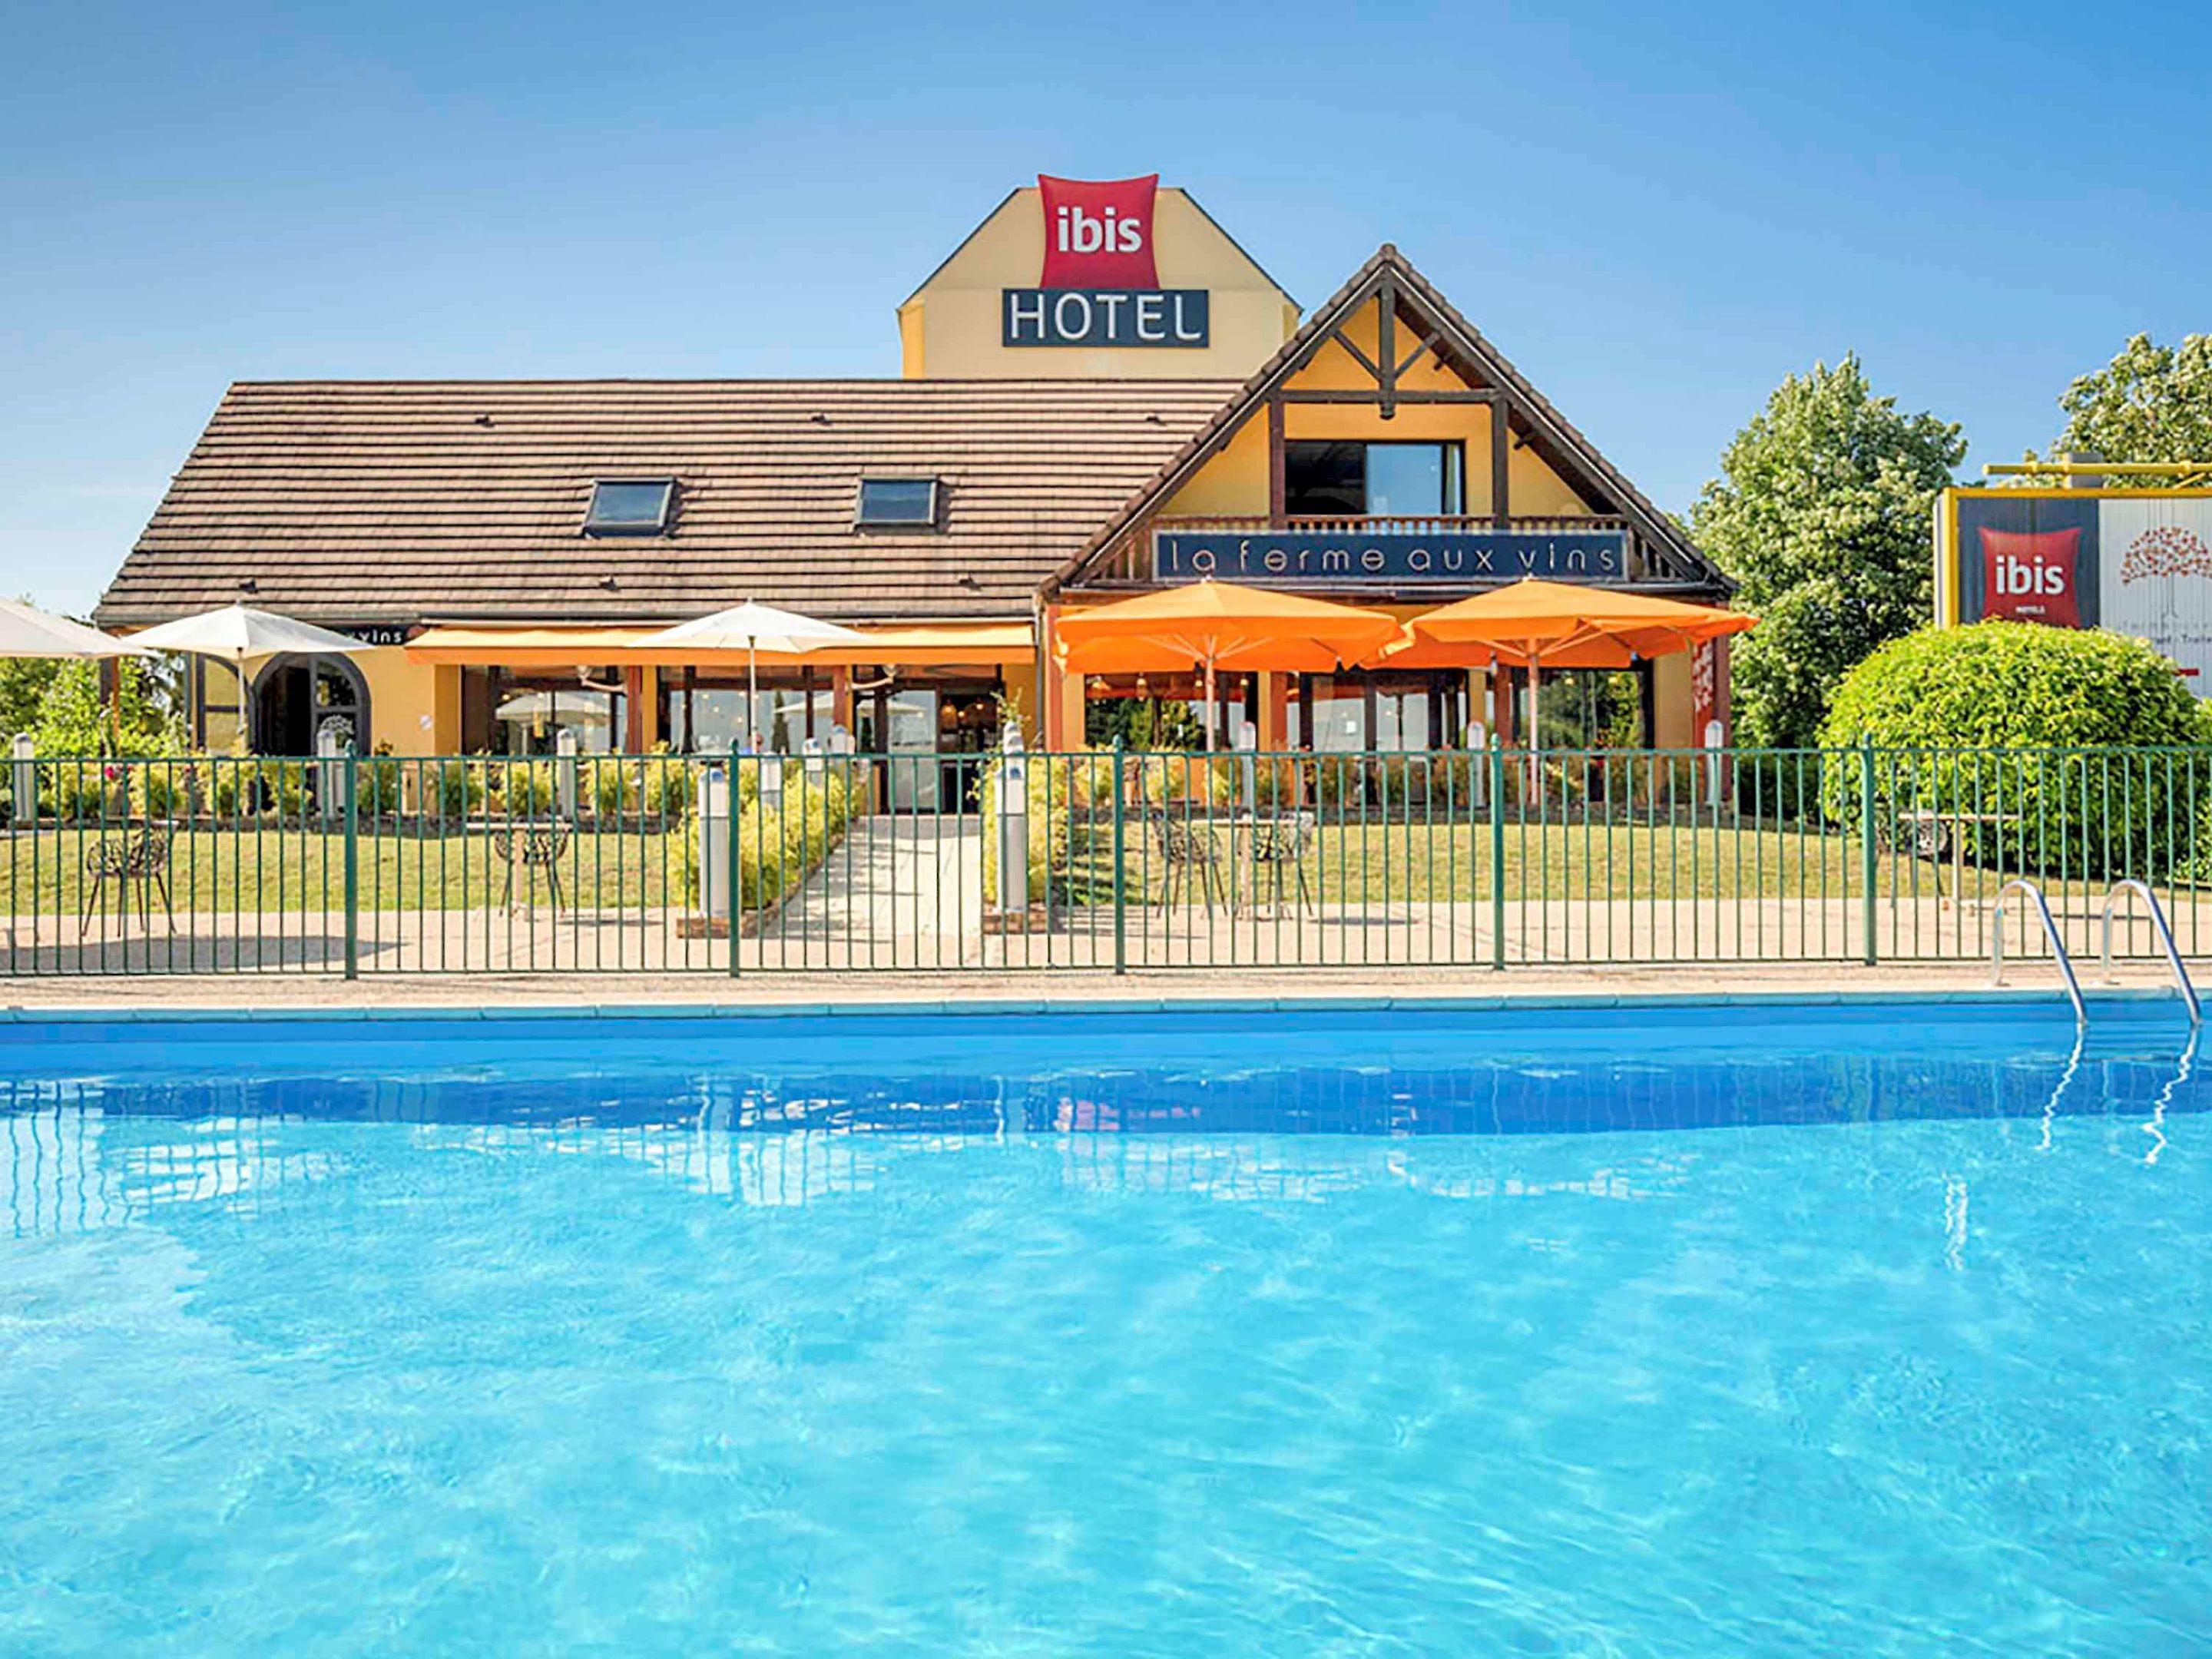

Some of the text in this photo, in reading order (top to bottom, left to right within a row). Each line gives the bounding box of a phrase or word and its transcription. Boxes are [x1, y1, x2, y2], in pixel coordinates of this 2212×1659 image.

[1057, 207, 1143, 253] ibis
[1010, 293, 1202, 340] HOTEL
[1171, 539, 1614, 571] la ferme aux vins
[1995, 555, 2065, 595] ibis
